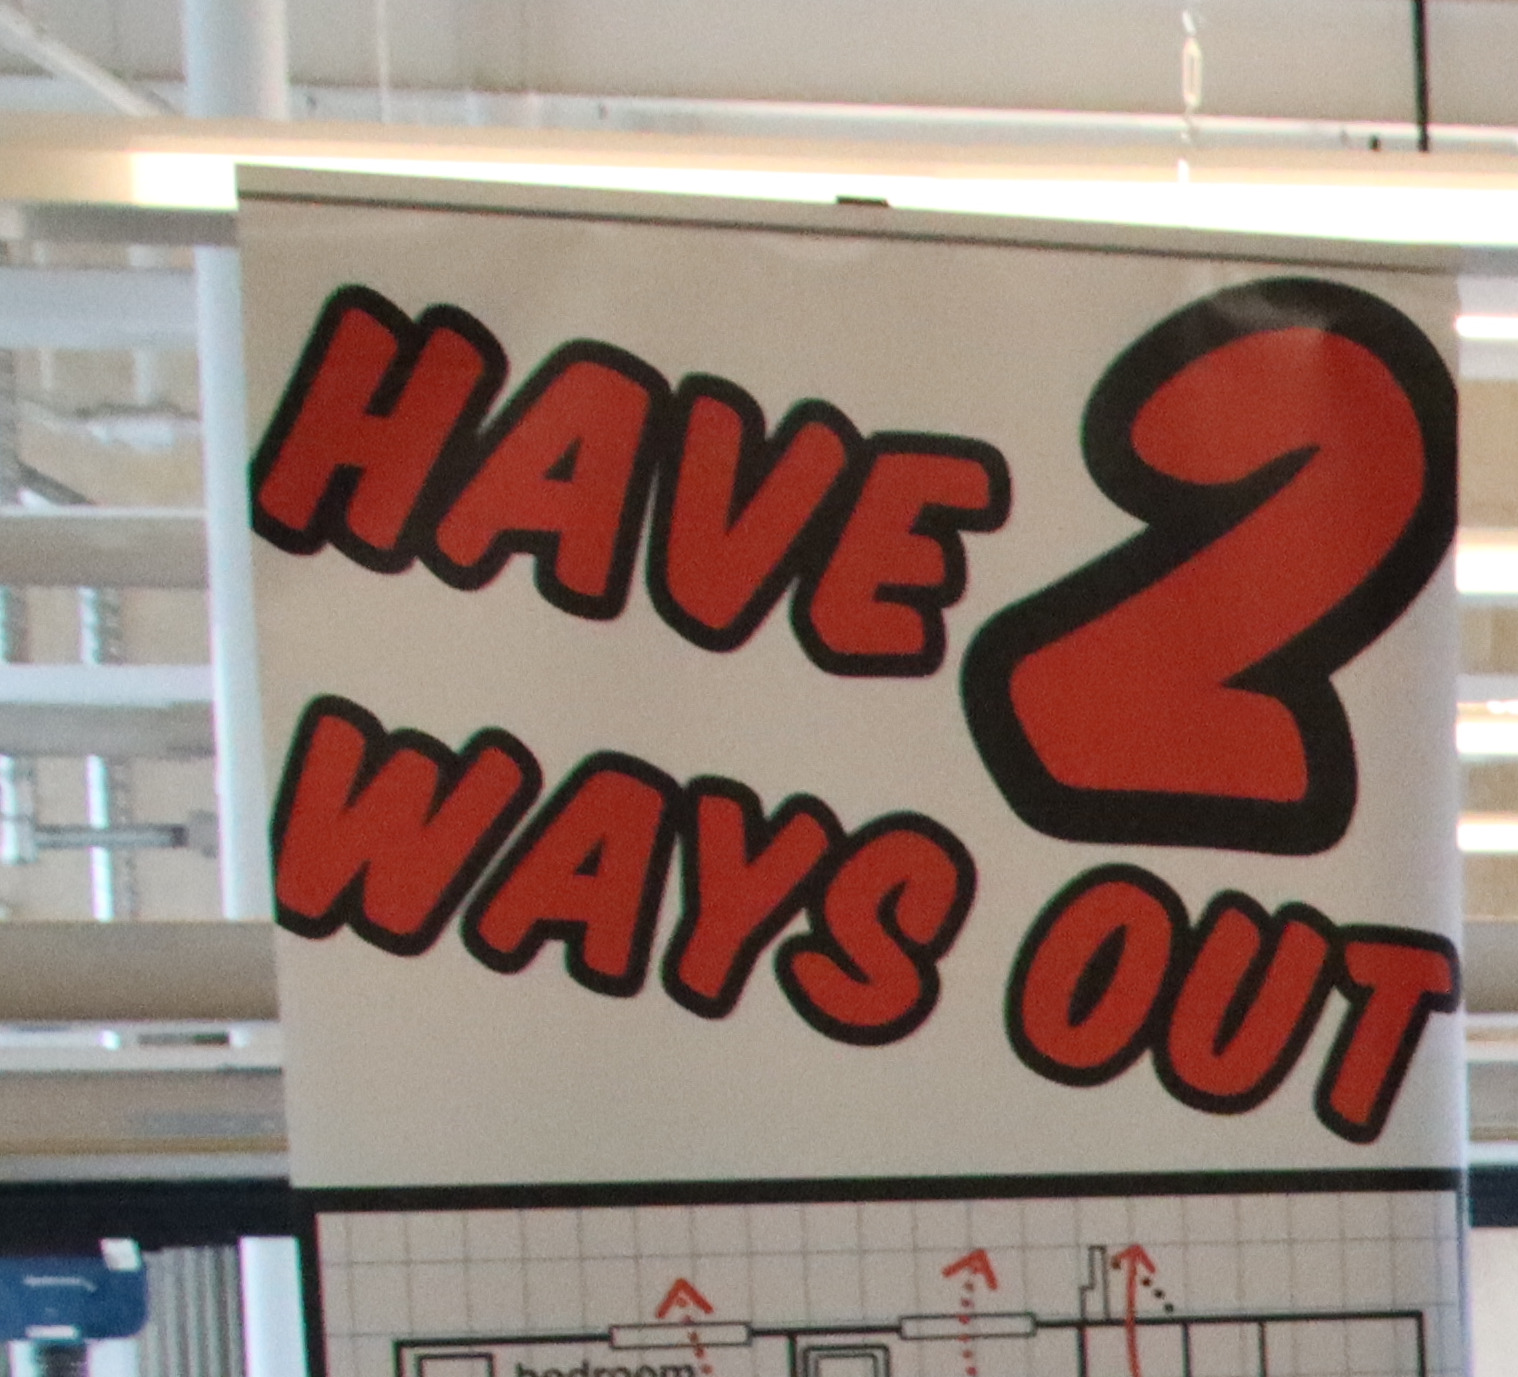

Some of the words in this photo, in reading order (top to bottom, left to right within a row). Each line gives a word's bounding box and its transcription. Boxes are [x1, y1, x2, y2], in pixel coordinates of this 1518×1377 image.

[249, 283, 1010, 676] HAVE
[962, 277, 1457, 855] 2
[270, 694, 977, 1046] WAYS
[1005, 863, 1459, 1144] OUT
